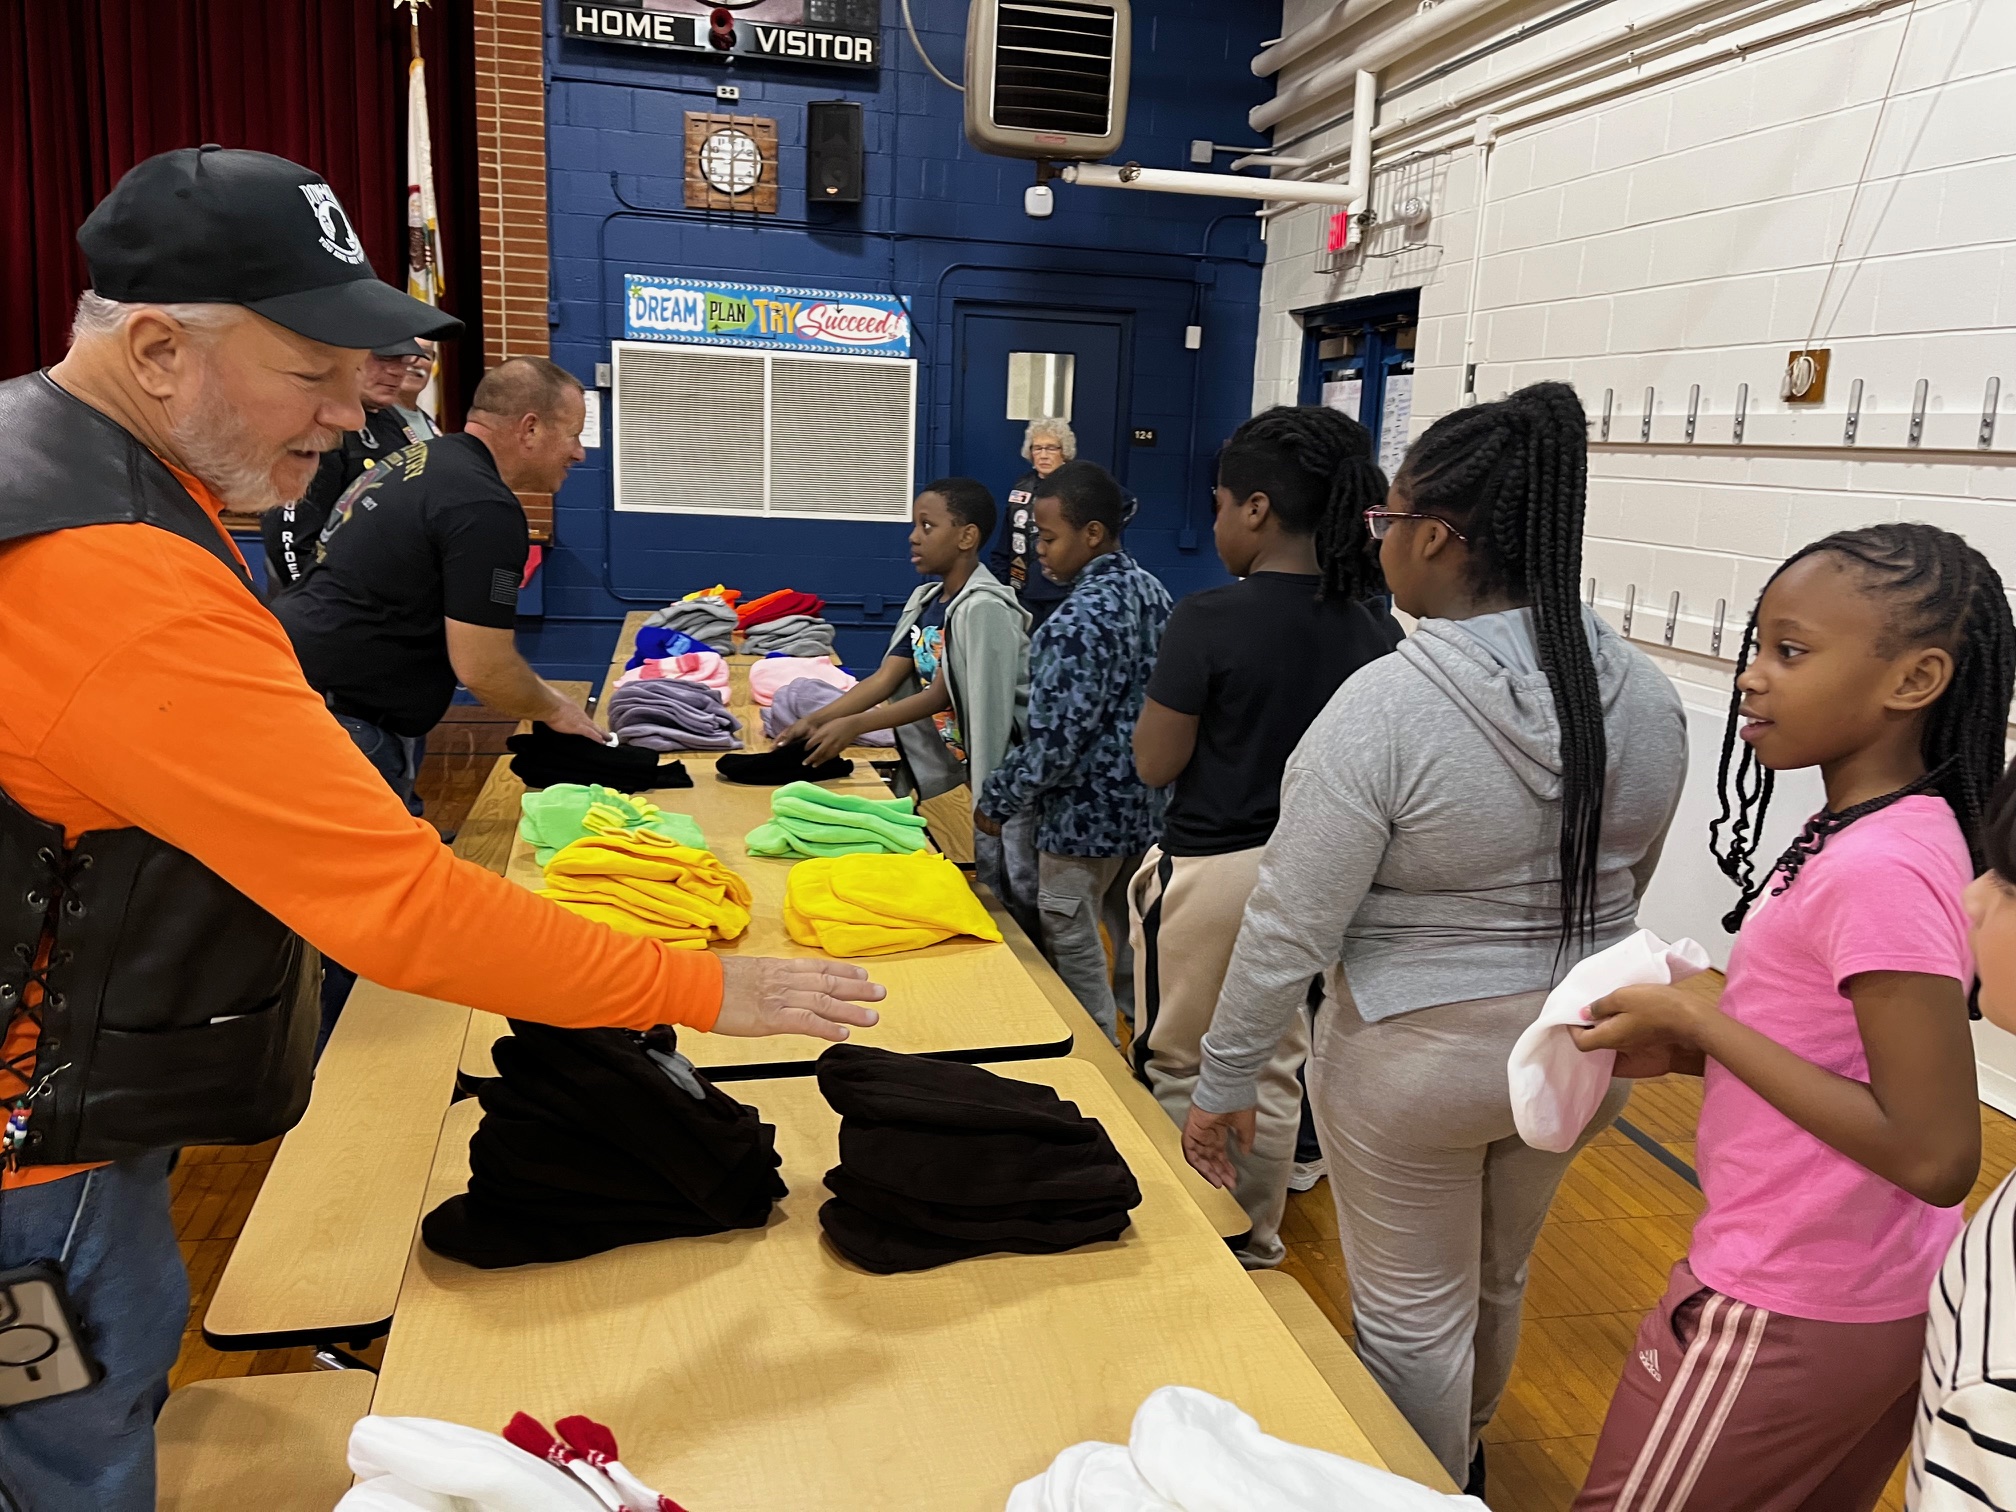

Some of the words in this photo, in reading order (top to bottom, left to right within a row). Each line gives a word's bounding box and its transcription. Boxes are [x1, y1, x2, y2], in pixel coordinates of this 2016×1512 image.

[576, 7, 675, 42] HOME
[755, 27, 873, 63] VISITOR
[636, 294, 698, 326] DREAM
[709, 300, 747, 323] PLAN
[752, 298, 802, 334] TRY
[797, 302, 905, 341] Succeed!
[1134, 430, 1153, 440] 124
